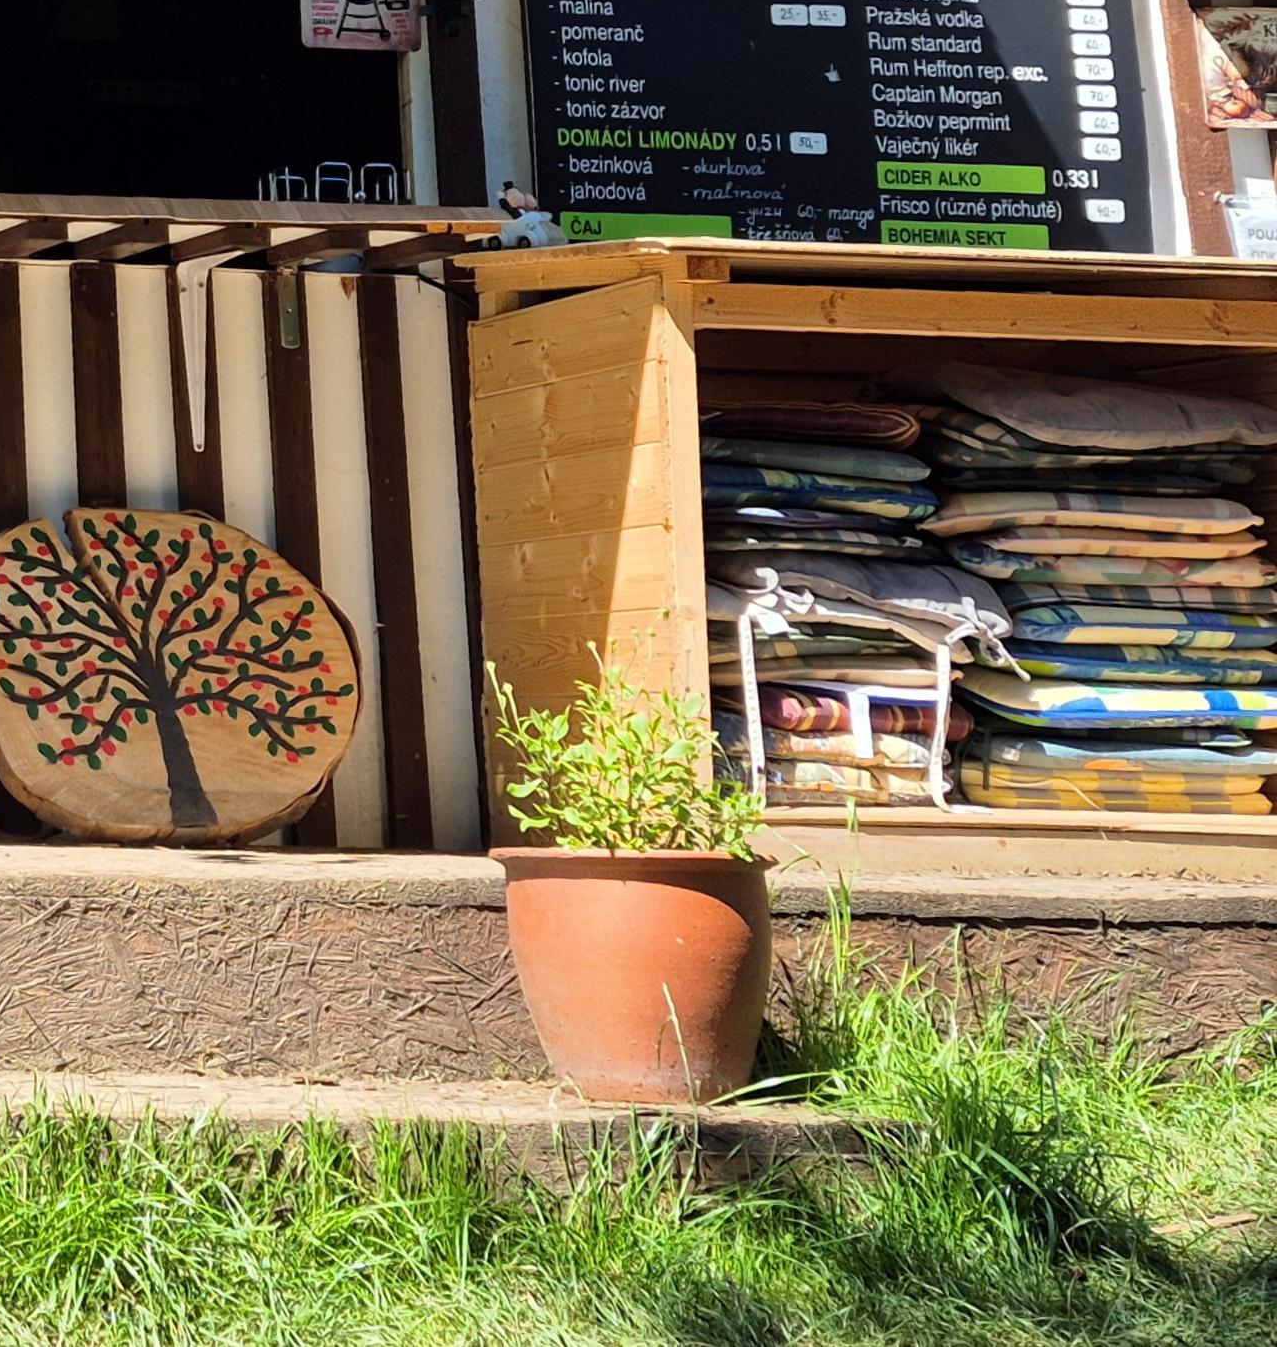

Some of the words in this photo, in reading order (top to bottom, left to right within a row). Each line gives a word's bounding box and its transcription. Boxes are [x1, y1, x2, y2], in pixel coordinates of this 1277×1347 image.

[872, 84, 935, 106] Captain
[940, 86, 1002, 109] Morgan
[558, 128, 631, 147] DOMÁCÍ
[639, 131, 736, 150] LIMONÁDY
[884, 169, 931, 185] CIDER
[938, 171, 981, 186] ALKO
[571, 216, 601, 235] ČAJ
[888, 228, 961, 244] BOHEMIA
[966, 230, 1006, 245] SEKT
